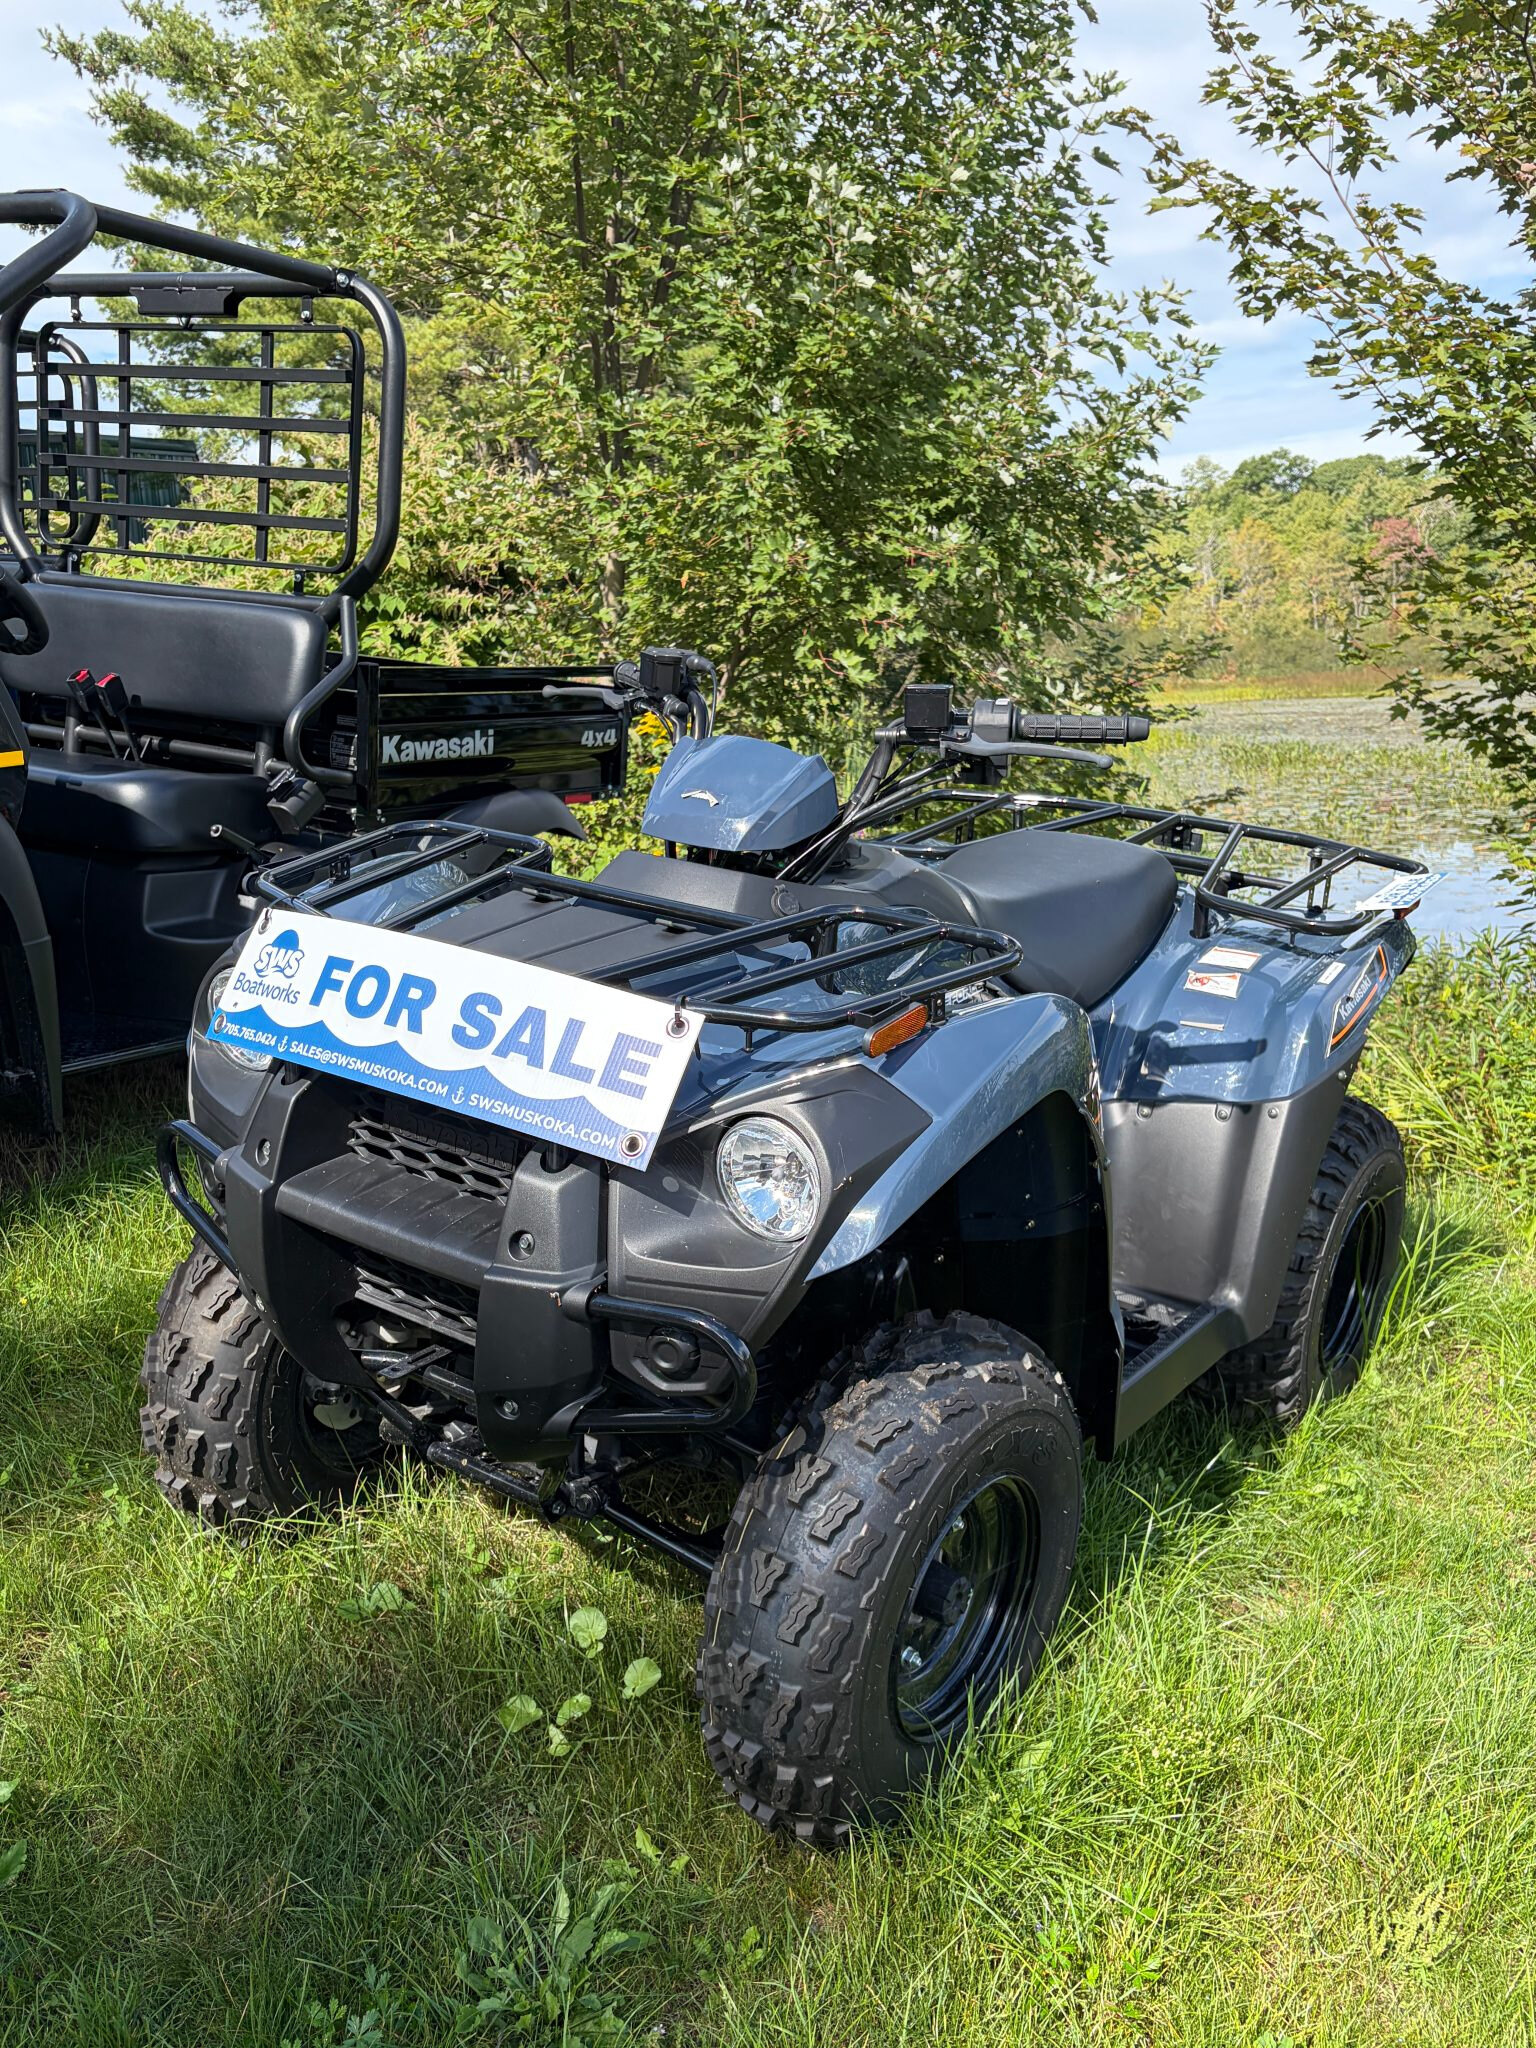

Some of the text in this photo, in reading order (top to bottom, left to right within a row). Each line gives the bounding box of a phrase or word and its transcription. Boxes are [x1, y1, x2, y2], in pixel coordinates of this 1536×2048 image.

[382, 728, 494, 763] Kawasaki
[581, 729, 617, 747] 4x4
[253, 942, 305, 979] SWS
[233, 972, 301, 1005] Boatworks
[309, 955, 662, 1100] FOR SALE
[223, 1022, 615, 1150] 705.765.0424 SALES@SWSMUSKOKA.COM SWSMUSKOKA.COM
